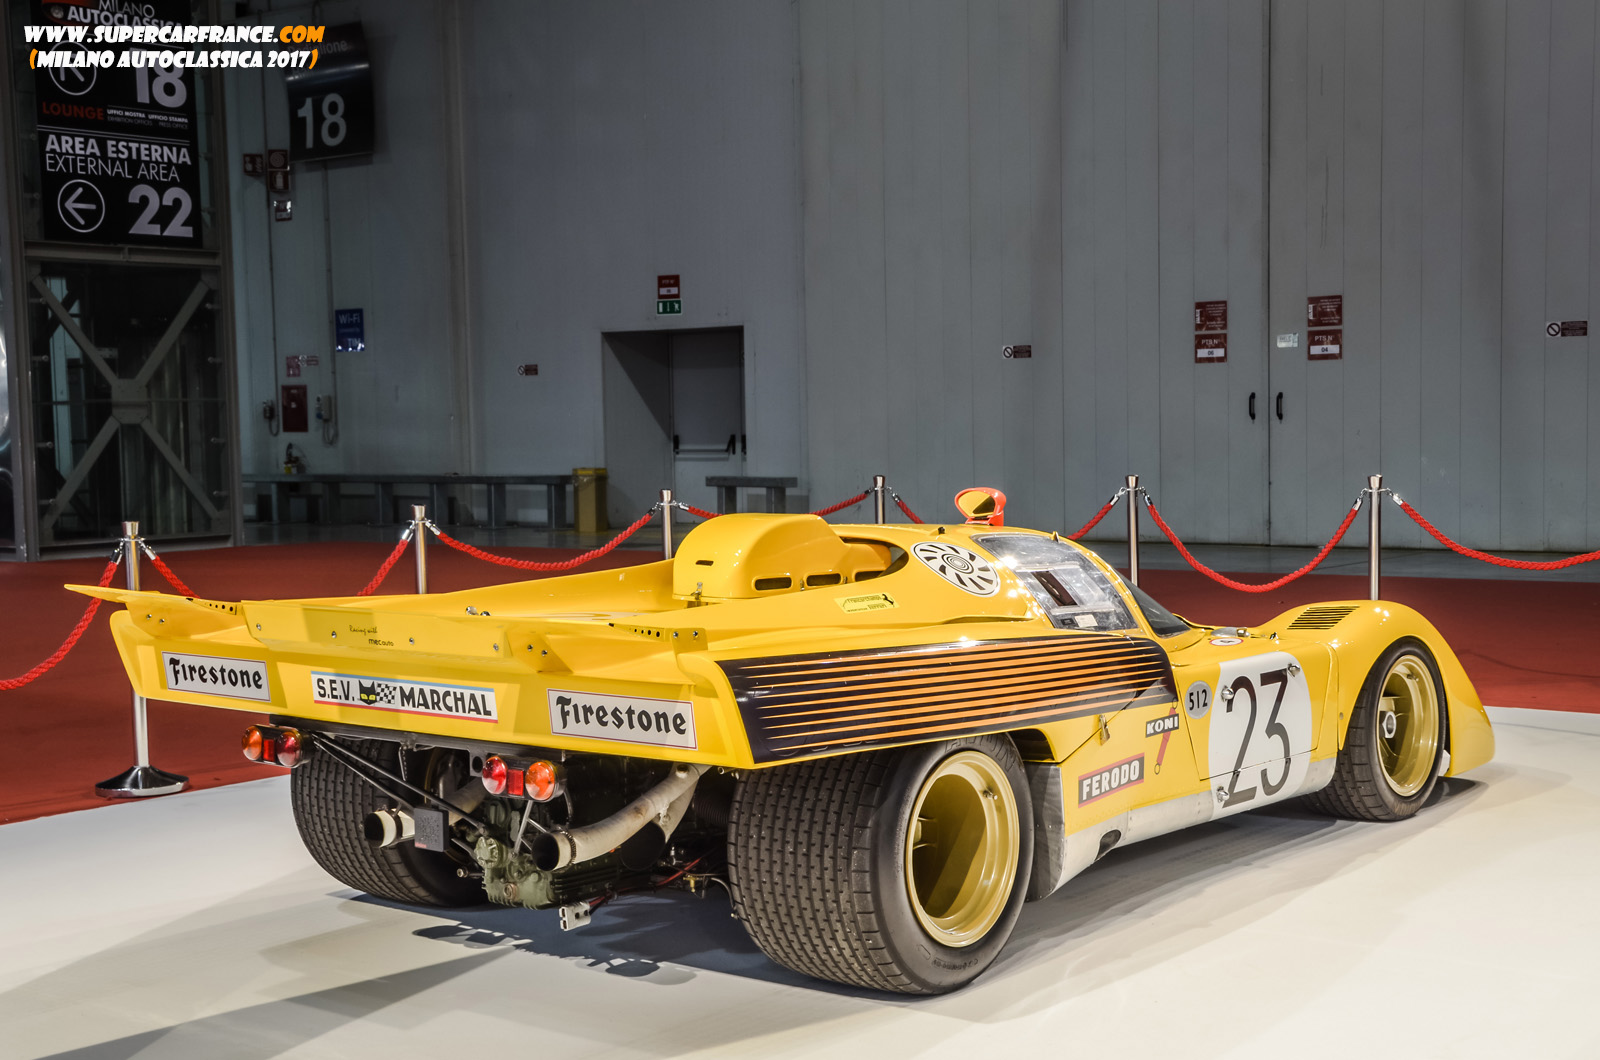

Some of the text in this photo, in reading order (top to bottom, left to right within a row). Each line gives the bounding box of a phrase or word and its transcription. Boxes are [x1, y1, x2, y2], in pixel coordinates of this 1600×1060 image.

[67, 6, 185, 29] AUTOCLASS
[98, 0, 156, 18] MILANO
[130, 47, 188, 109] 18
[42, 101, 104, 121] LOUNGE
[124, 110, 146, 118] MOSTRA
[148, 113, 168, 121] UFFICIO
[297, 92, 348, 150] 18
[45, 134, 192, 165] AREA ESTERNA
[45, 153, 181, 183] EXTERNAL AREA
[128, 183, 194, 239] 22
[169, 657, 263, 690] Firestone
[316, 678, 492, 717] S.E.V. MARCHAL
[1189, 689, 1208, 711] 512
[556, 695, 687, 735] Firestone
[1146, 716, 1179, 735] KONI
[1222, 668, 1291, 809] 23
[1082, 760, 1140, 801] FERODO
